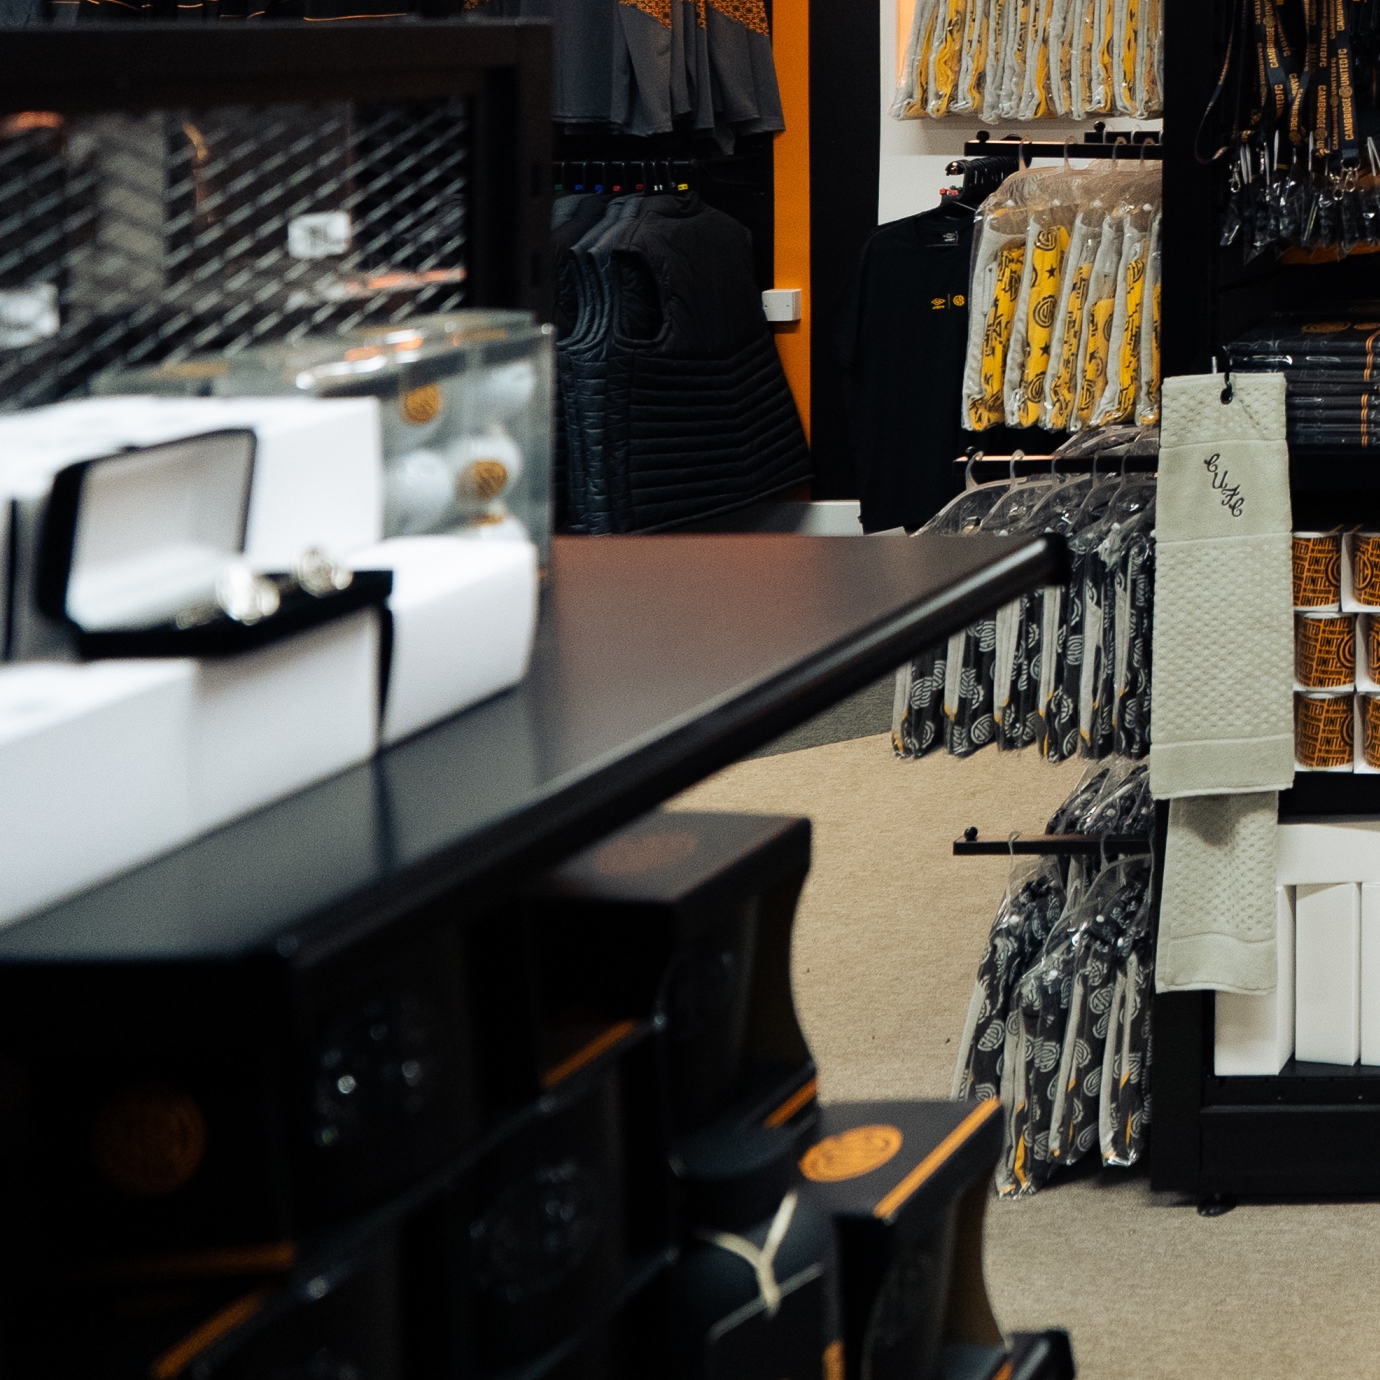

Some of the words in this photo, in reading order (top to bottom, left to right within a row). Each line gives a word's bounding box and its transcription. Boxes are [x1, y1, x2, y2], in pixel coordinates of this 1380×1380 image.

[1266, 27, 1278, 68] CAMBRIDGE
[1339, 58, 1349, 86] UNITED
[1317, 85, 1326, 128] CAMBRIDGE
[1342, 98, 1354, 140] CAMBRIDGE
[1203, 453, 1245, 518] CUFC
